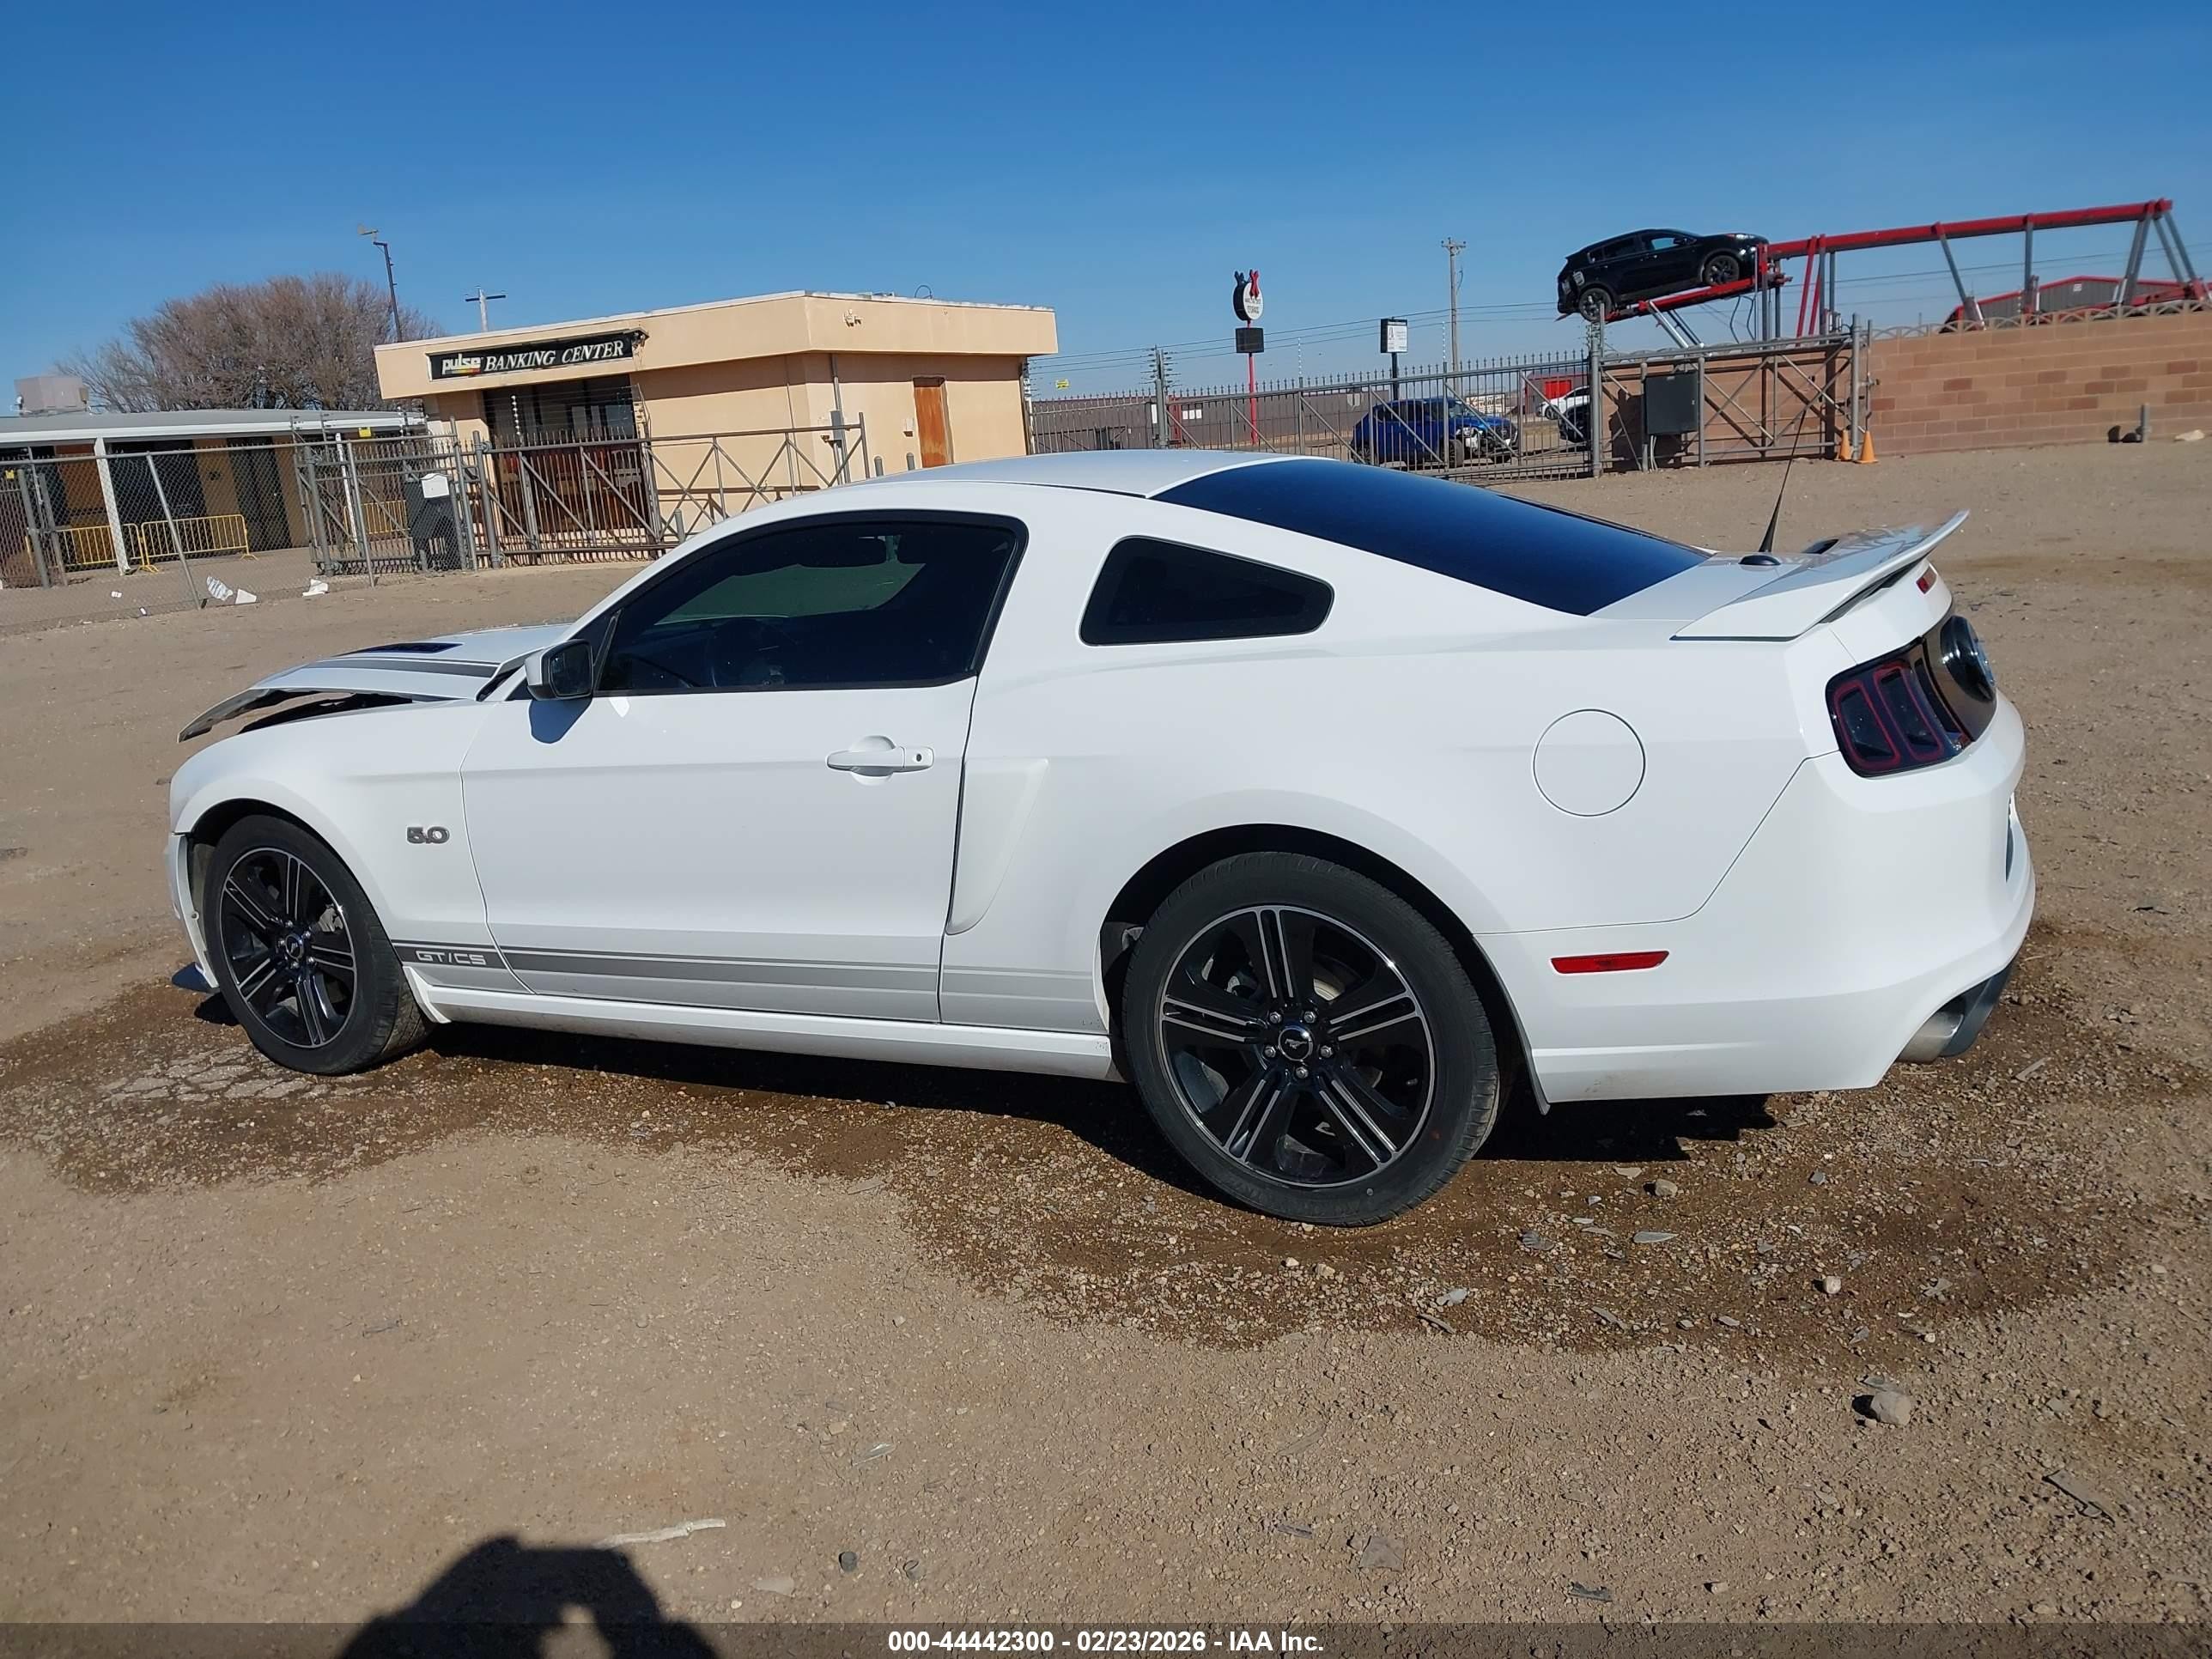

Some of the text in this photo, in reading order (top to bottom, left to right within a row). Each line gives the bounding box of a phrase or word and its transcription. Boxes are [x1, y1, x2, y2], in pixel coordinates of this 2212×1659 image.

[441, 340, 624, 375] pulse BANKING CENTER
[406, 826, 450, 844] 5.0
[415, 950, 487, 966] GT/CS
